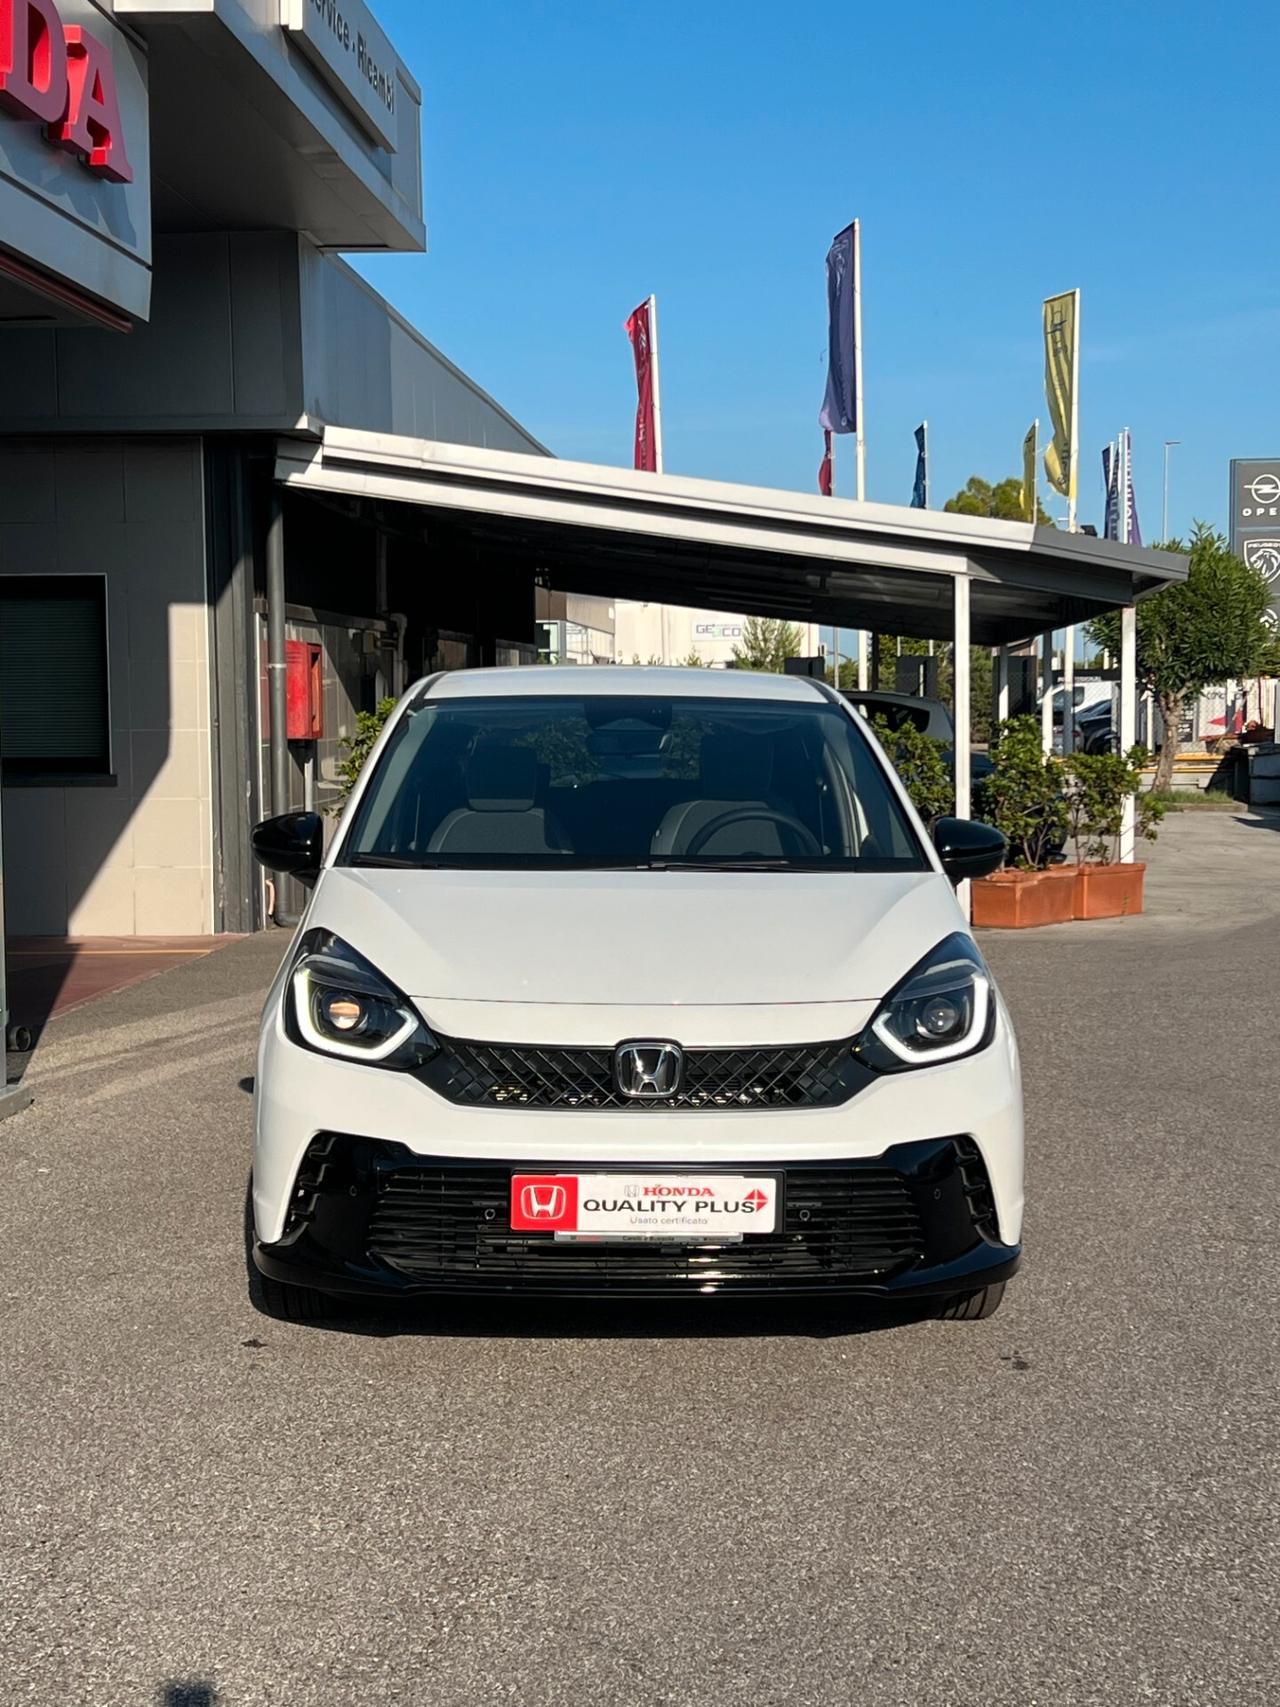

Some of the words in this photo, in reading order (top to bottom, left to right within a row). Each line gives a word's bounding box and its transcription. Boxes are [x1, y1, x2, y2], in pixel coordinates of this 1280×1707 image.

[357, 31, 394, 114] Ricambi
[643, 1186, 715, 1197] HONDA
[583, 1200, 688, 1213] QUALITY
[695, 1201, 756, 1214] PLUS
[630, 1217, 659, 1225] Usato
[660, 1217, 708, 1225] certificato
